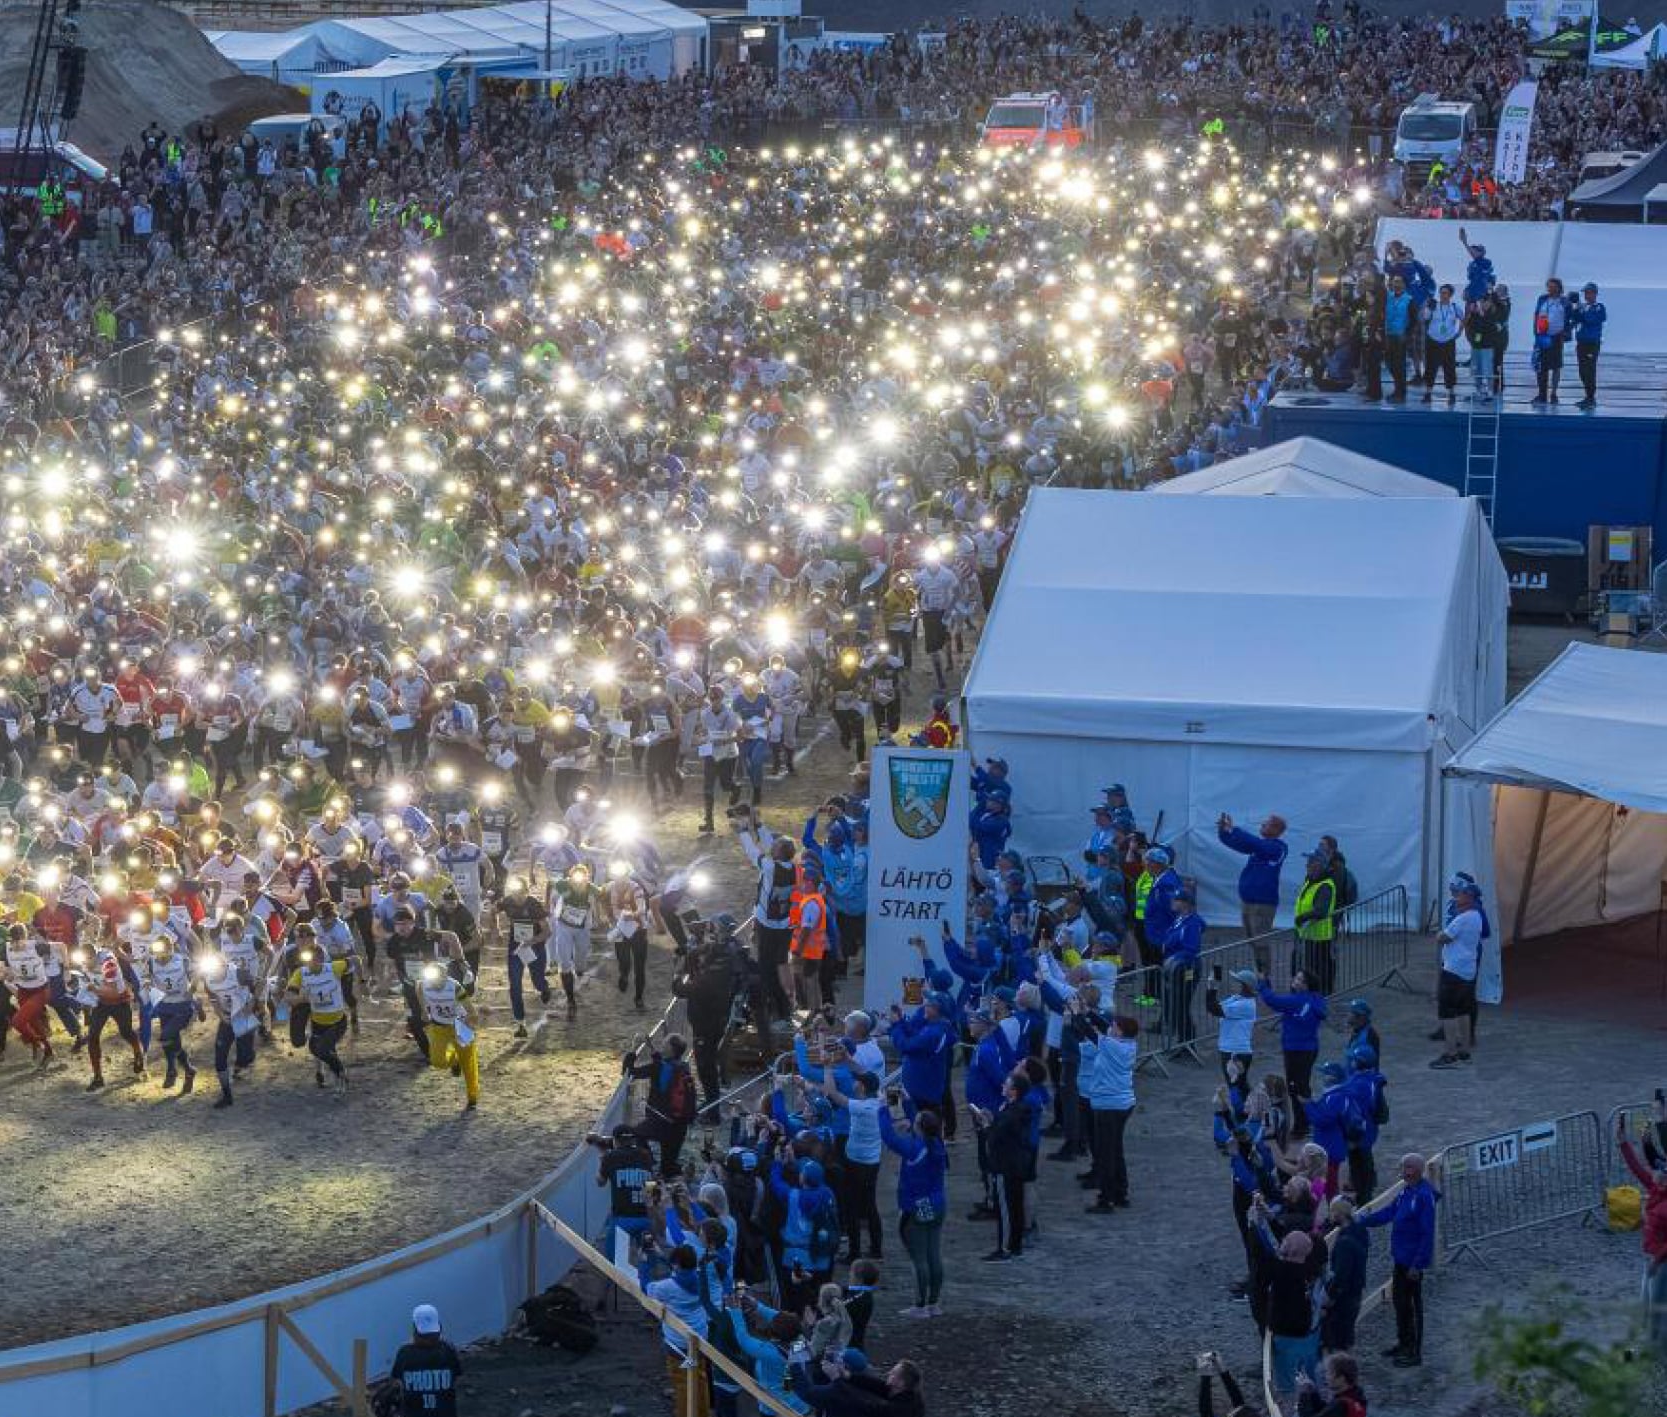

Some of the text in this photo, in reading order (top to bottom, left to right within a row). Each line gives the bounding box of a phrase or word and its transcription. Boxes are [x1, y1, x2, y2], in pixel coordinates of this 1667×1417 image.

[880, 867, 952, 890] LÄHTÖ
[879, 899, 946, 920] START
[1479, 1139, 1513, 1167] EXIT
[403, 1369, 451, 1391] PHOTO
